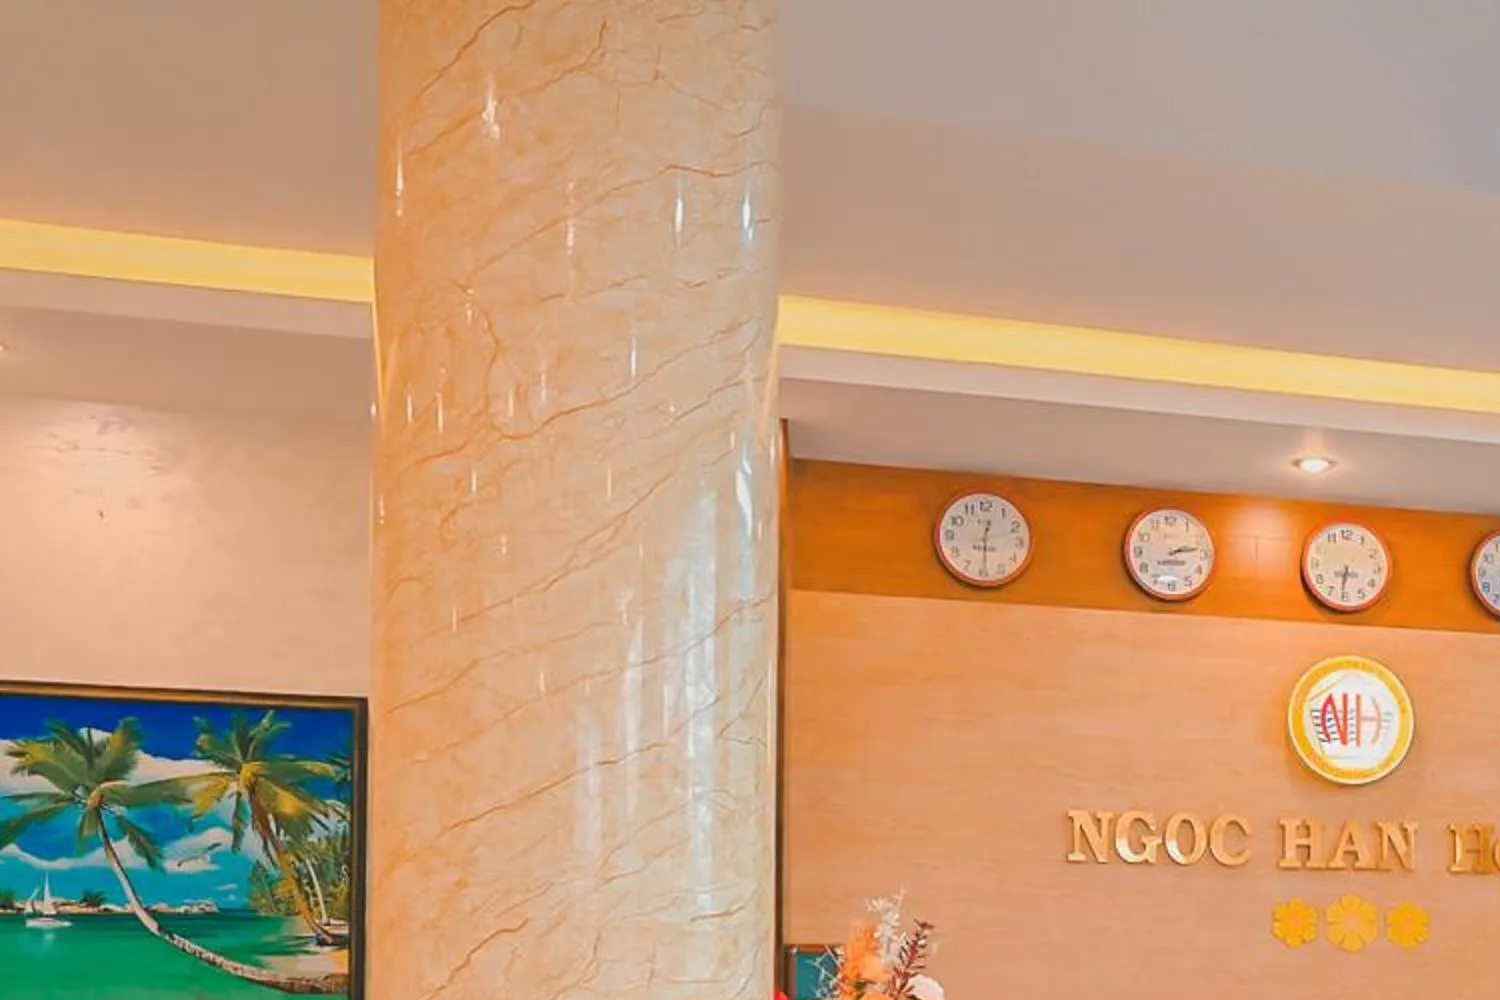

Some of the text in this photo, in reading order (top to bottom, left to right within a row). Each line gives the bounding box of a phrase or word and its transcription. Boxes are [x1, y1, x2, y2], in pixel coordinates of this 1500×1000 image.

[965, 503, 975, 516] 11
[980, 501, 993, 512] 12
[951, 515, 964, 527] 10
[1011, 519, 1021, 533] 2
[1327, 531, 1337, 544] 11
[1341, 529, 1353, 541] 12
[1184, 576, 1193, 588] 5
[1066, 809, 1252, 866] NGOC
[1278, 817, 1419, 871] HAN
